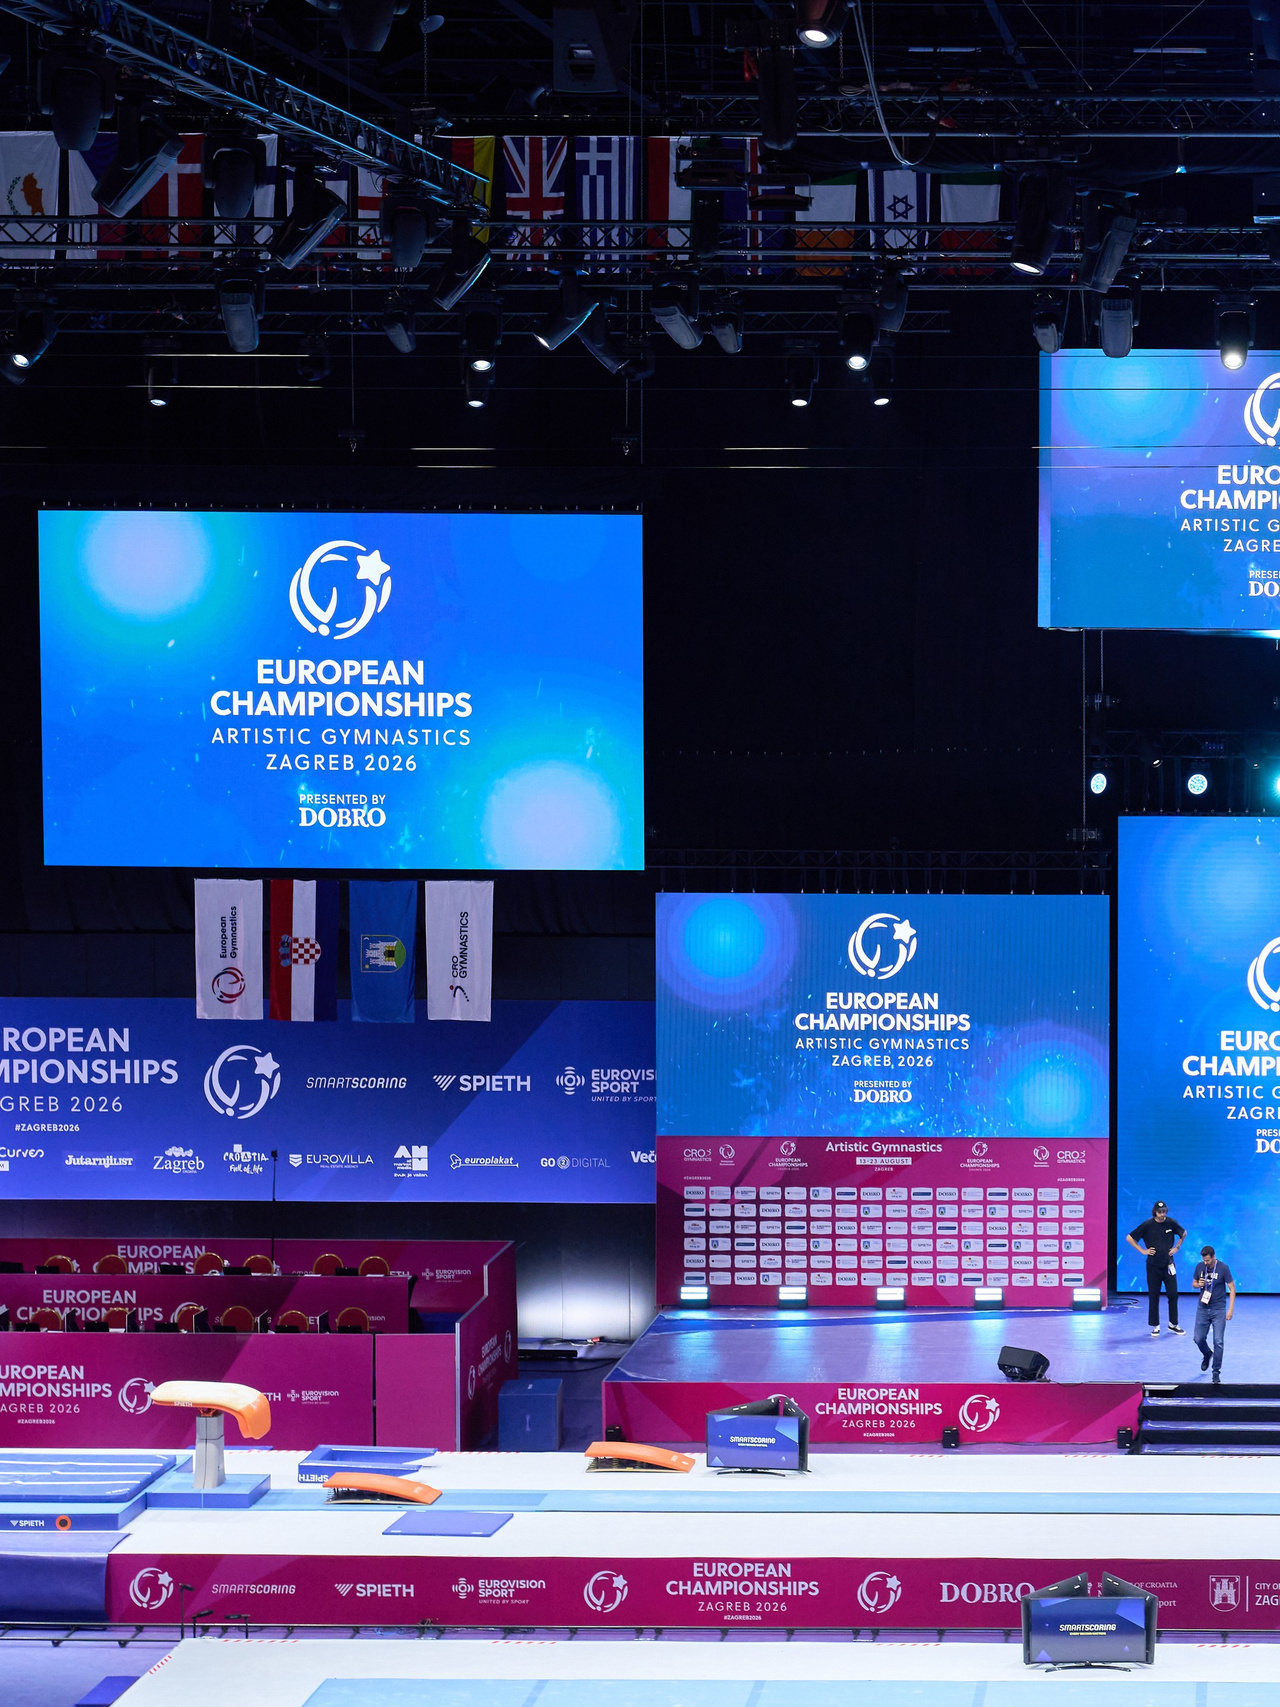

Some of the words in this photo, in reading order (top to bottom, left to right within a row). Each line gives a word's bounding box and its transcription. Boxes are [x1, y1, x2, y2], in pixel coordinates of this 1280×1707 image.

[1180, 518, 1259, 532] ARTISTIC
[257, 659, 424, 685] EUROPEAN
[210, 690, 472, 717] CHAMPIONSHIPS
[211, 728, 311, 745] ARTISTIC
[321, 728, 470, 746] GYMNASTICS
[266, 754, 354, 770] ZAGREB
[365, 754, 417, 771] 2026
[299, 794, 368, 805] PRESENTED
[372, 794, 386, 805] BY
[298, 807, 386, 828] DOBRO
[220, 916, 228, 959] European
[229, 906, 238, 959] Gymnastics
[459, 911, 469, 979] GYMNASTICS
[826, 992, 938, 1010] EUROPEAN
[795, 1013, 970, 1031] CHAMPIONSHIPS
[795, 1038, 862, 1049] ARTISTIC
[869, 1038, 969, 1050] GYMNASTICS
[832, 1055, 891, 1067] ZAGREB
[898, 1055, 933, 1067] 2026
[306, 1077, 407, 1089] SMARTSCORING
[459, 1075, 530, 1091] SPIETH
[591, 1081, 639, 1093] SPORT
[854, 1080, 900, 1088] PRESENTED
[902, 1080, 912, 1088] BY
[853, 1089, 912, 1103] DOBRO
[1183, 1085, 1264, 1099] ARTISTIC
[71, 1096, 122, 1112] 2026
[15, 1123, 80, 1132] #ZAGREB2026
[683, 1148, 705, 1158] CRO
[825, 1141, 869, 1152] Artistic
[871, 1141, 942, 1155] Gymnastics
[1057, 1150, 1079, 1160] CRO
[223, 1151, 269, 1162] CROATIA
[306, 1154, 374, 1164] EUROVILLA
[464, 1156, 513, 1166] europlakat
[153, 1156, 205, 1174] Zagreb
[117, 1245, 206, 1260] EUROPEAN
[43, 1289, 136, 1304] EUROPEAN
[838, 1388, 919, 1400] EUROPEAN
[49, 1403, 80, 1413] 2026
[815, 1402, 942, 1415] CHAMPIONSHIPS
[842, 1420, 885, 1428] ZAGREB
[890, 1420, 916, 1428] 2026
[693, 1562, 791, 1577] EUROPEAN
[212, 1584, 296, 1594] SMARTSCORING
[356, 1583, 414, 1597] SPIETH
[478, 1579, 546, 1589] EUROVISION
[666, 1580, 819, 1596] CHAMPIONSHIPS
[479, 1588, 515, 1598] SPORT
[940, 1582, 1036, 1603] DOBRO
[698, 1601, 750, 1611] ZAGREB
[756, 1602, 787, 1612] 2026
